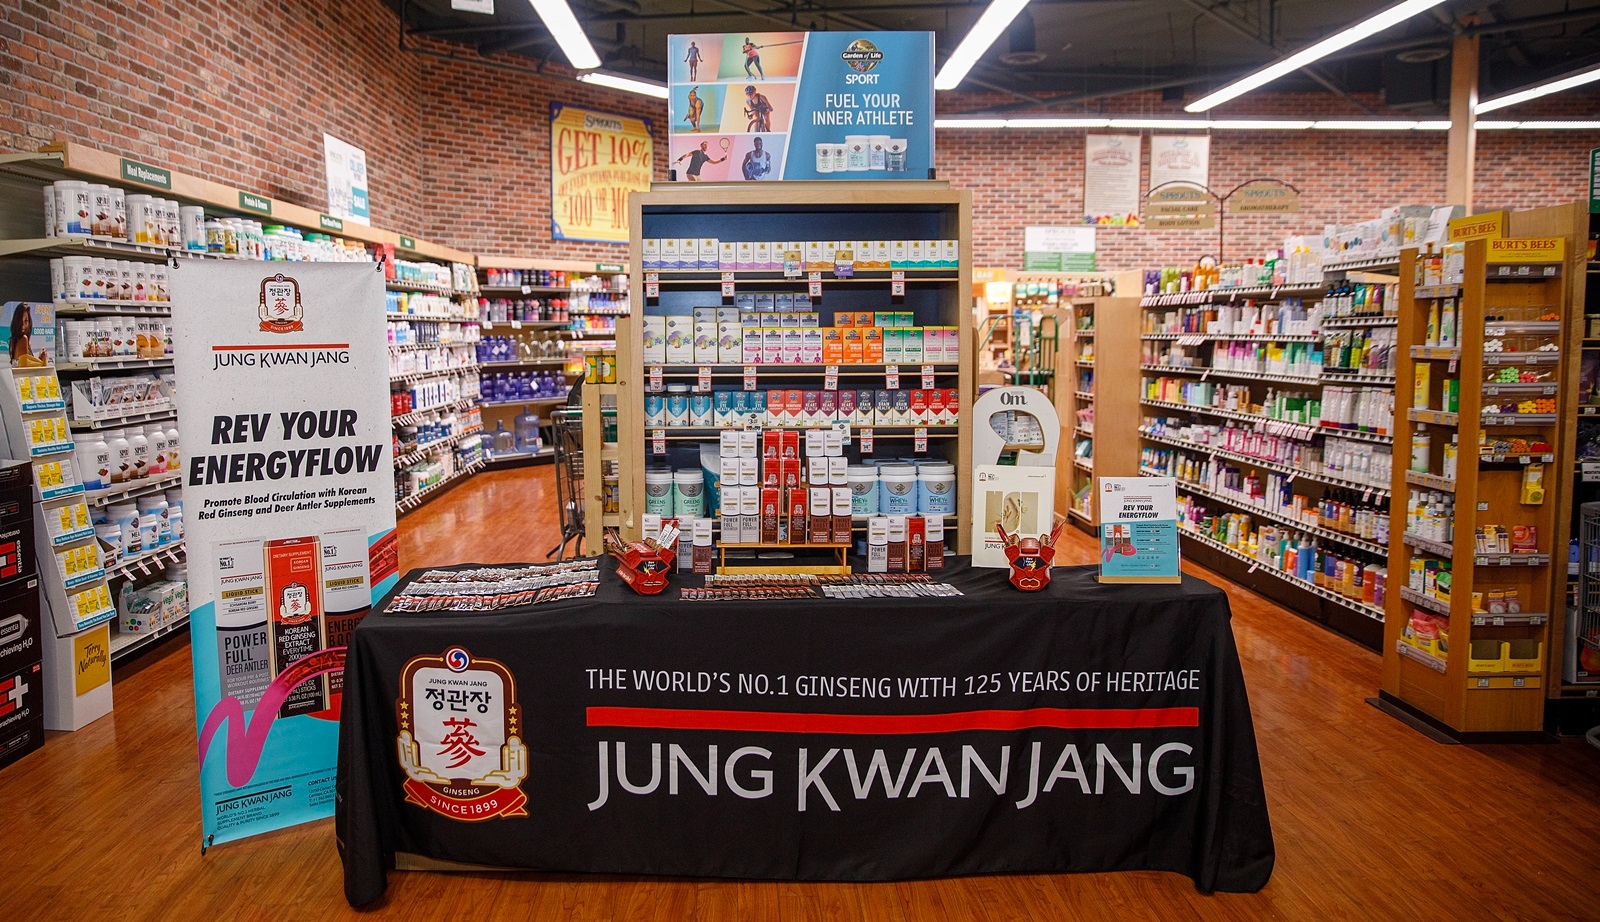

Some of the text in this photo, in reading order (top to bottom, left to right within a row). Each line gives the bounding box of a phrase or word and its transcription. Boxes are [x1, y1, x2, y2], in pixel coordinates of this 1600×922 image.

[864, 52, 870, 60] of
[845, 73, 880, 85] SPORT
[825, 93, 901, 108] FUEL YOUR
[813, 111, 914, 125] INNER ATHLETE
[558, 127, 651, 176] GET 10%
[126, 164, 167, 185] Meal Replacements
[1159, 190, 1201, 200] SPROUTS
[1244, 188, 1285, 197] SPROUTS
[1453, 222, 1497, 238] BURT'S BEES
[1492, 240, 1556, 249] BURT'S BEES
[213, 351, 350, 370] JUNG KWAN JANG
[1000, 391, 1028, 406] Om
[211, 409, 358, 445] REV YOUR
[188, 444, 383, 486] ENERGYFLOW
[204, 486, 367, 508] Promote Blood Circulation with Korean
[198, 496, 376, 520] Red Ginseng and Deer Antler Supplements
[351, 562, 363, 570] JANG
[1, 623, 19, 636] essentia
[284, 626, 309, 635] KOREAN
[290, 631, 316, 641] GINSENG
[224, 631, 267, 650] POWER
[284, 638, 310, 648] EXTRACT
[84, 643, 101, 657] Terry
[225, 648, 253, 664] FULL
[282, 645, 314, 655] EVERYTIME
[78, 651, 107, 675] Naturally
[226, 659, 269, 676] DEER ANTLER
[227, 680, 248, 688] WORKOUT
[301, 684, 316, 693] STICKS
[586, 668, 1200, 698] THE WORLD'S NO.1 GINSENG WITH 125 YEARS OF HERITAGE
[425, 687, 492, 714] 정관장
[436, 717, 486, 769] 蔘
[307, 777, 330, 786] CONTACT
[587, 740, 1195, 812] JUNG KWAN JANG
[442, 786, 480, 796] GINSENG
[216, 801, 240, 816] JUNG
[241, 794, 269, 809] KWAN
[269, 789, 292, 803] JANG
[430, 795, 498, 815] SINCE 1899
[217, 811, 262, 826] SUPPLEMENT BRAND
[217, 823, 236, 831] QUALITY
